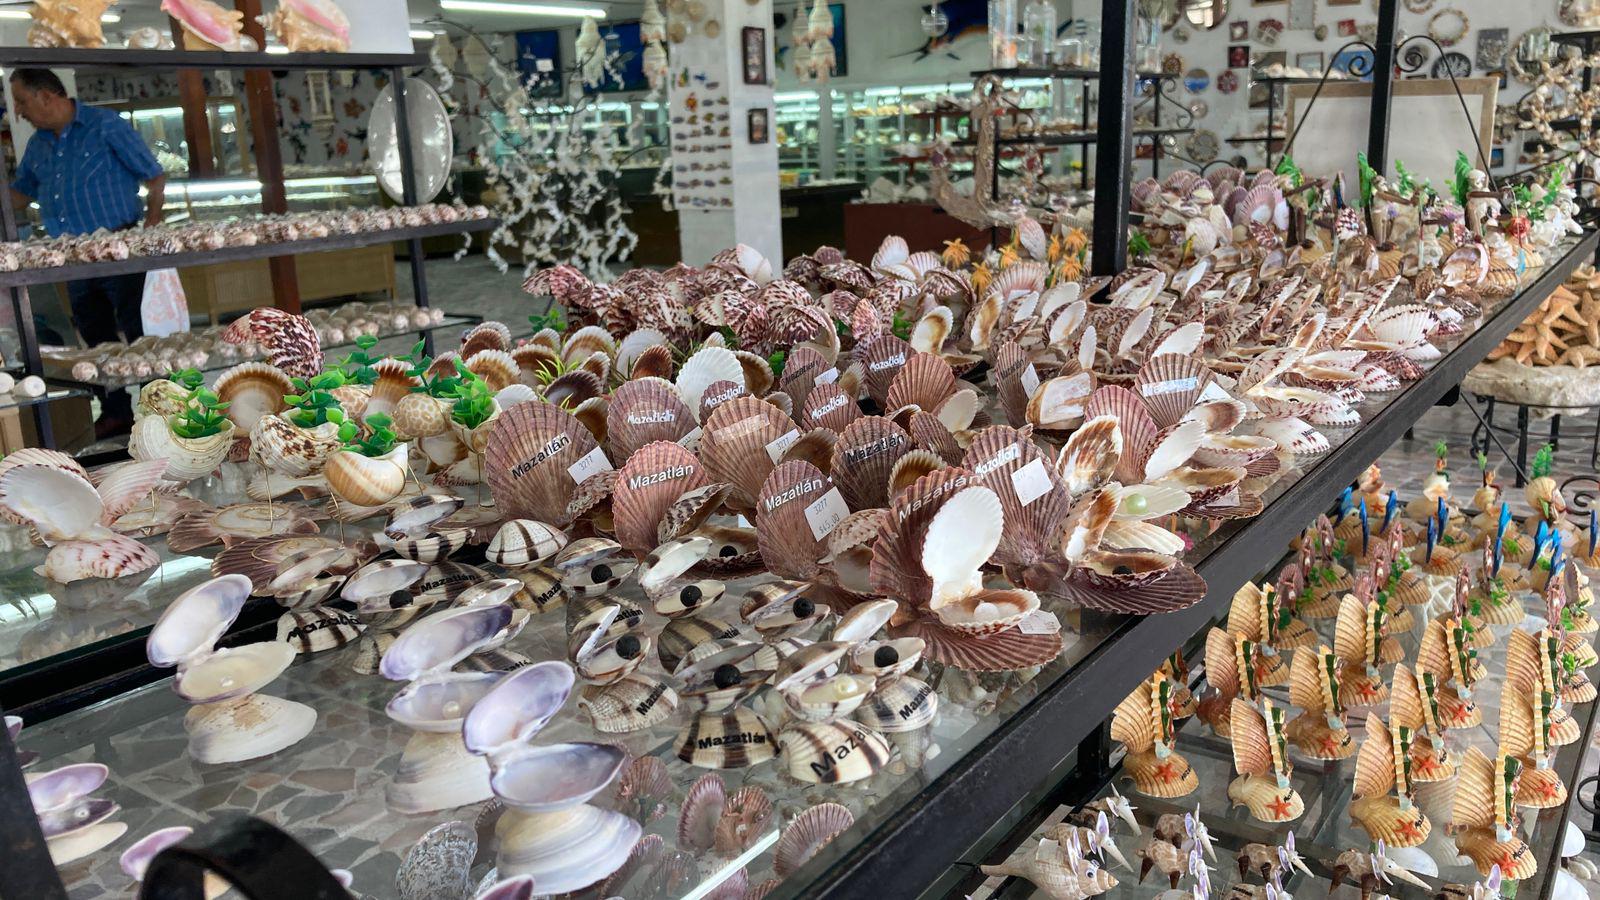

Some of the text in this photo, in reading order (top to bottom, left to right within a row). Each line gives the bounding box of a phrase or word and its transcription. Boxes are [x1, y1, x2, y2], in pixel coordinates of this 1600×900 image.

[704, 384, 745, 407] Mazatlán
[511, 434, 570, 480] Mazatlán
[847, 434, 905, 464] Mazatlán
[630, 464, 694, 490] Mazatlán
[765, 478, 822, 512] Mazatlán
[815, 497, 828, 515] 3277
